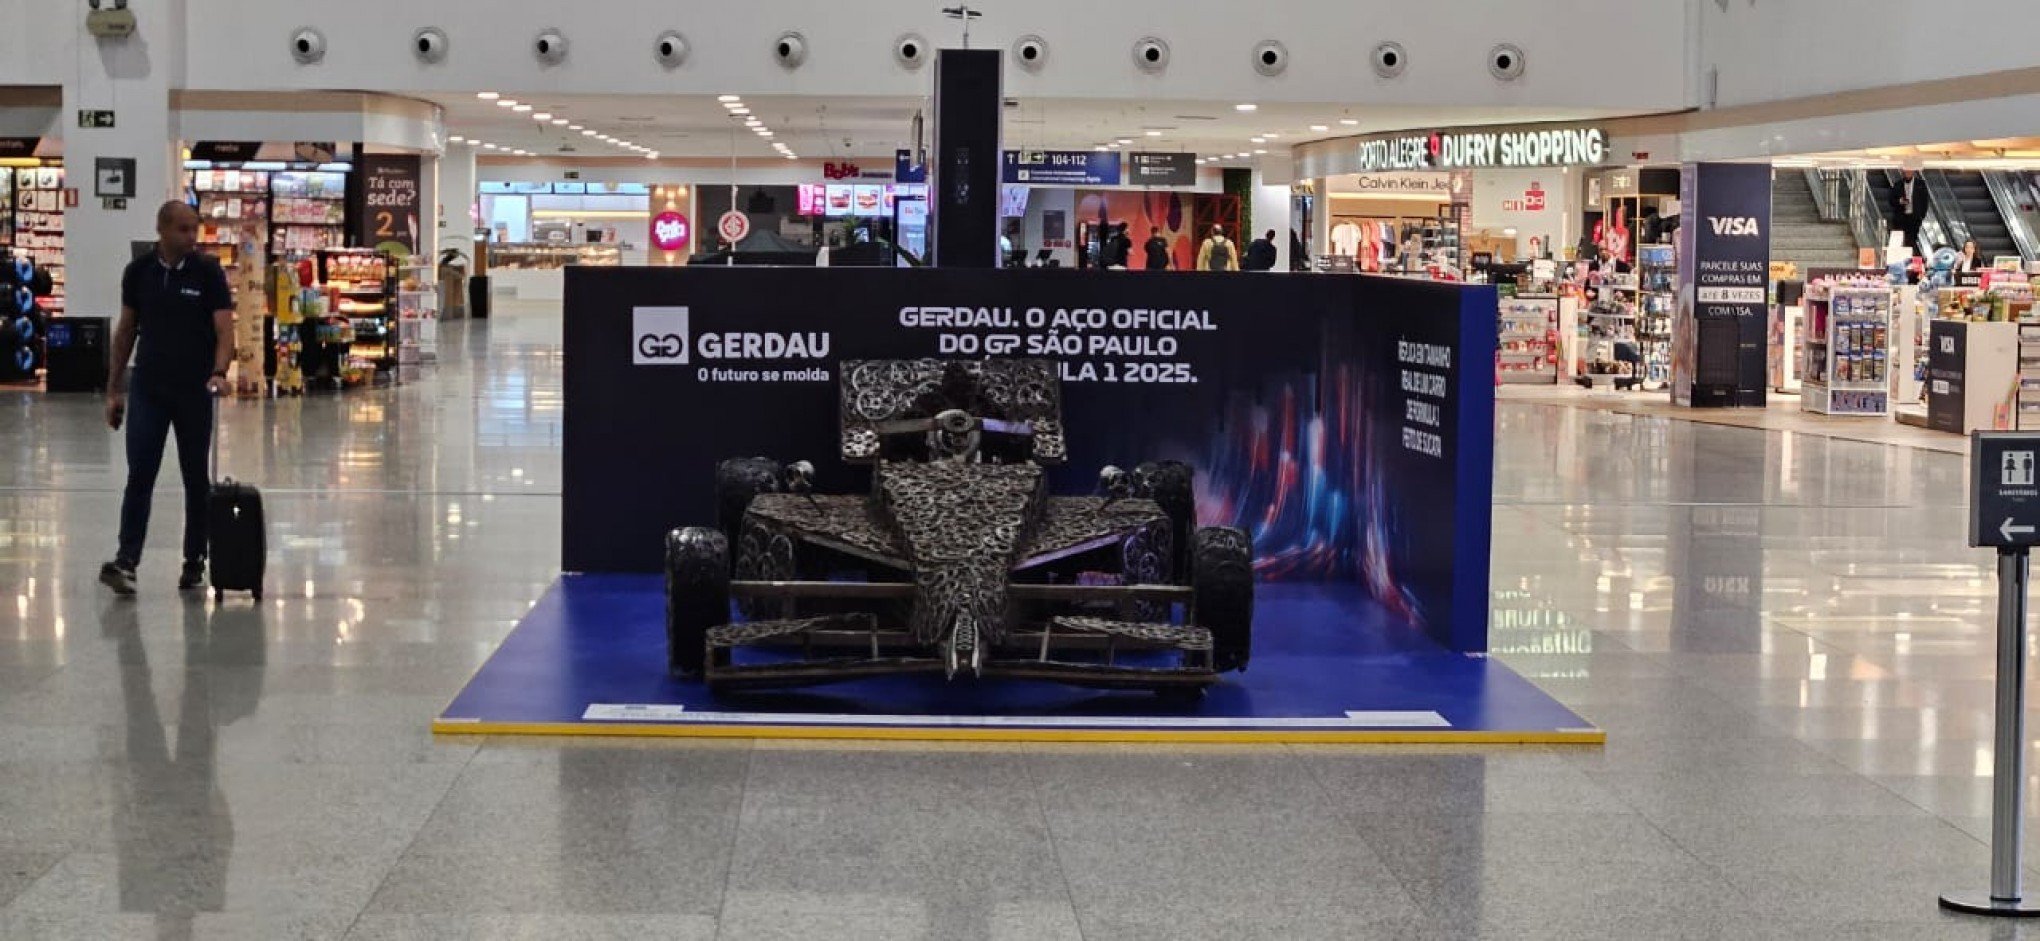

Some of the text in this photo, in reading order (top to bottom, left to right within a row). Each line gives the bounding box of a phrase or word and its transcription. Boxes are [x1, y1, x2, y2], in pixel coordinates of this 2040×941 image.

[1360, 128, 1602, 170] PORTO ALEGRE DUFRY SHOPPING
[1051, 153, 1087, 166] 104-112
[389, 179, 413, 189] com
[1359, 176, 1398, 189] Calvin
[1401, 176, 1428, 189] Klein
[367, 189, 417, 206] sede?
[1707, 216, 1759, 236] VISA
[1700, 260, 1738, 272] PARCELE
[1740, 260, 1763, 272] SUAS
[1701, 273, 1762, 285] COMPRAS EM
[1732, 290, 1761, 301] VEZES
[899, 306, 1217, 332] GERDAU. O AÇO OFICIAL
[1708, 306, 1730, 317] COM
[697, 332, 830, 359] GERDAU
[939, 328, 1177, 356] DO GP SÃO PAULO
[697, 366, 829, 382] O futuro se molda
[1103, 362, 1118, 382] 1
[1123, 362, 1198, 383] 2025.
